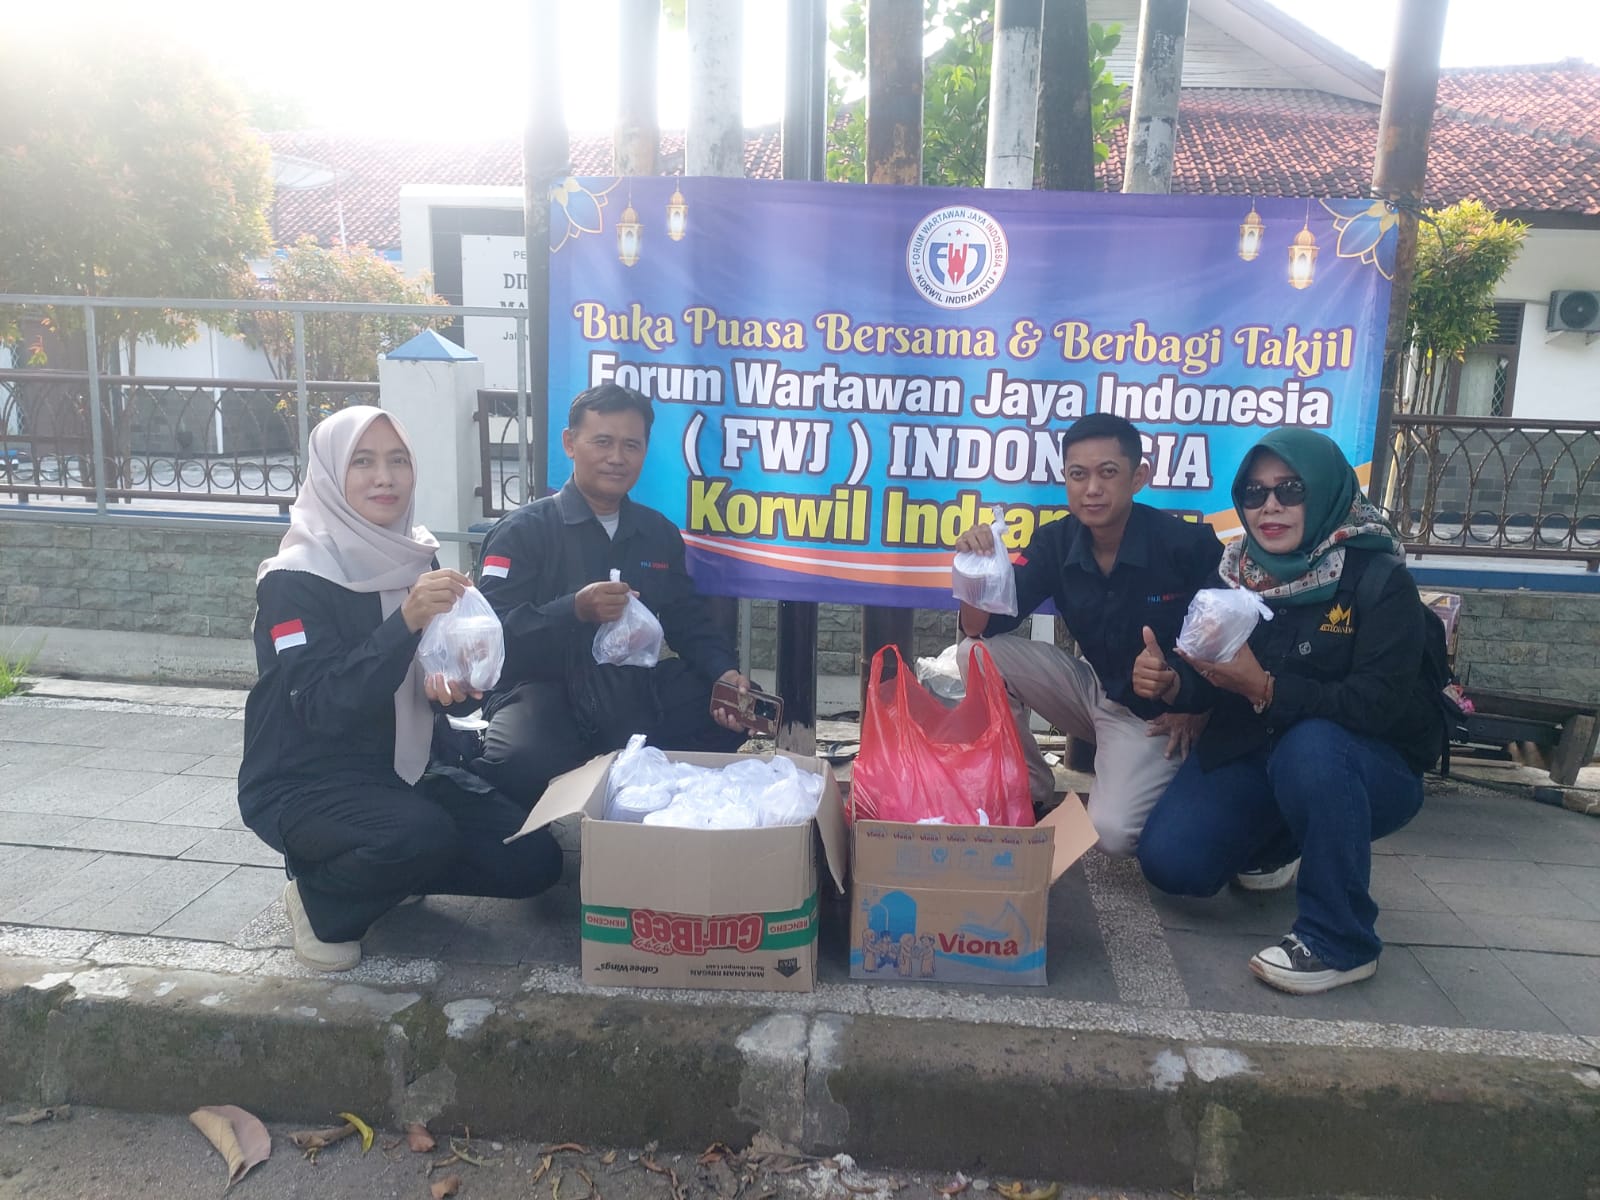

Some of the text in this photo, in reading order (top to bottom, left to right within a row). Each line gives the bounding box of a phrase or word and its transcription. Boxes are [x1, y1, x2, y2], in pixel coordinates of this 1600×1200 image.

[912, 210, 1003, 268] FORUM WARTAWAN JAYA INDONESIA
[916, 274, 995, 304] KORWIL INDRAMAYU
[573, 303, 1353, 377] Buka Puasa Bersama & Berbagi Takjil
[591, 353, 1330, 425] Forum Wartawan Jaya Indonesia
[722, 418, 831, 473] FWJ
[888, 426, 1211, 488] INDONIA
[690, 480, 868, 541] Korwil
[633, 910, 763, 954] GuriBee
[937, 932, 1019, 956] Viona
[723, 969, 765, 978] MAKANAN
